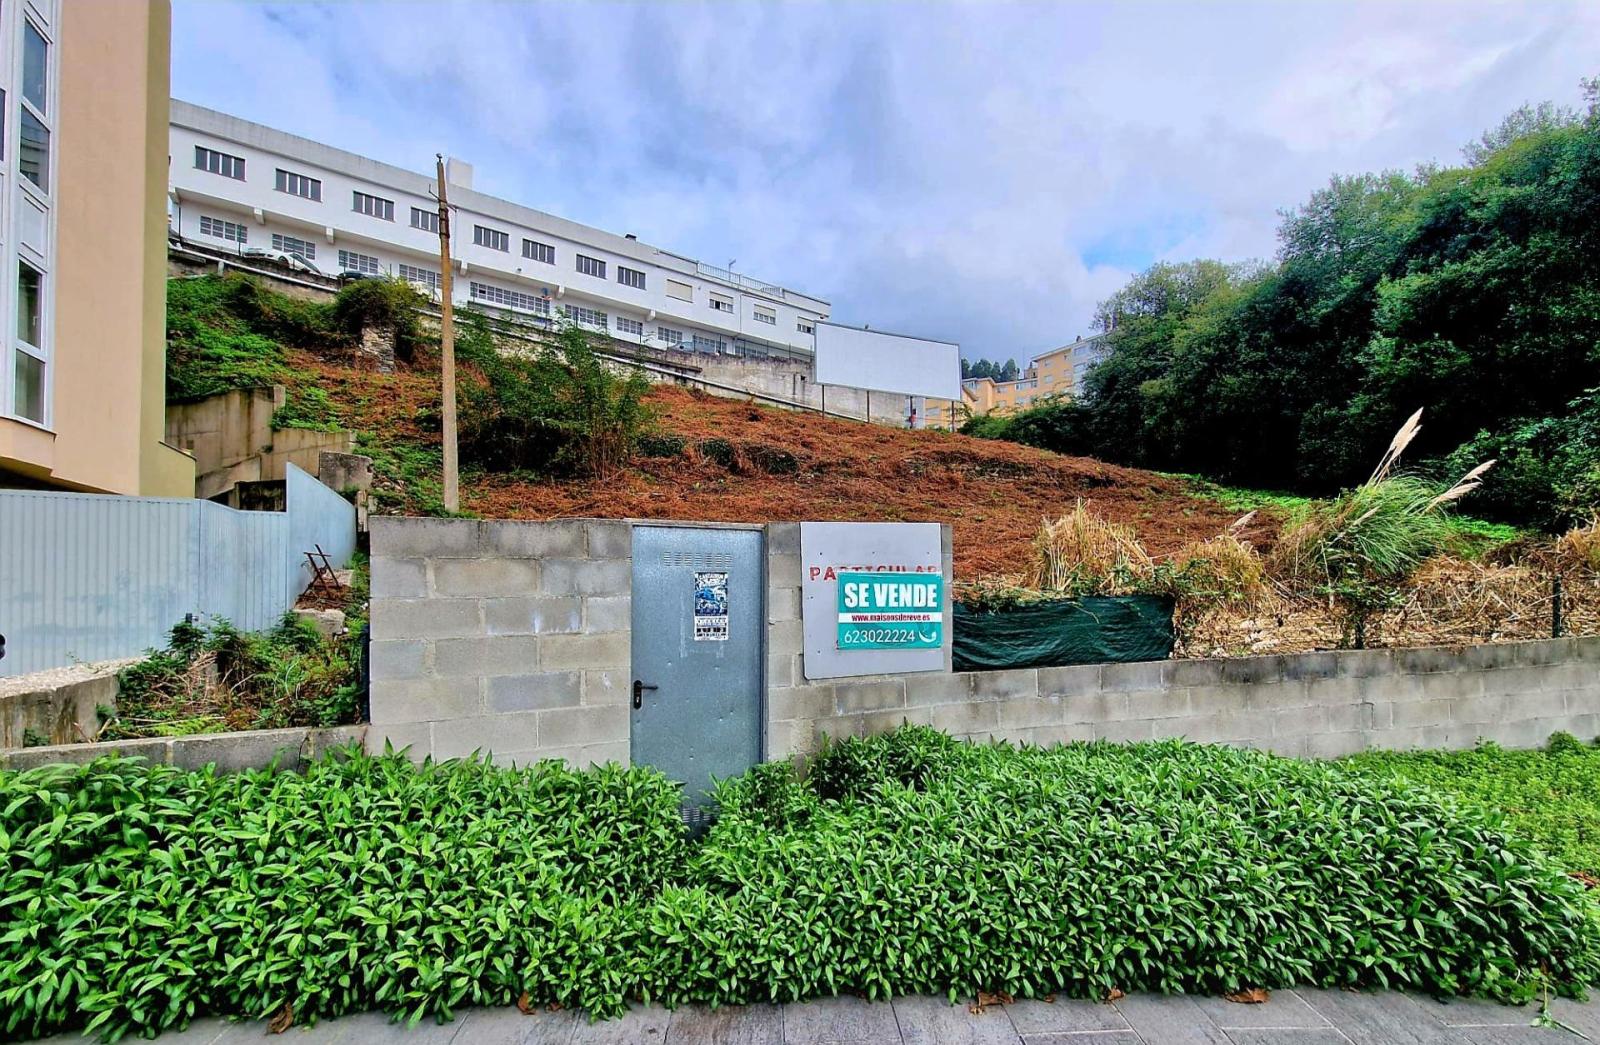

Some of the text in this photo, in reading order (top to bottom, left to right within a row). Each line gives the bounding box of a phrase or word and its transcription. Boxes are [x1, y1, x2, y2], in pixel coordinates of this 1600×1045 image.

[844, 582, 938, 608] SE VENDE
[851, 613, 931, 622] www.maisonsdereve.es
[844, 629, 916, 644] 623022224
